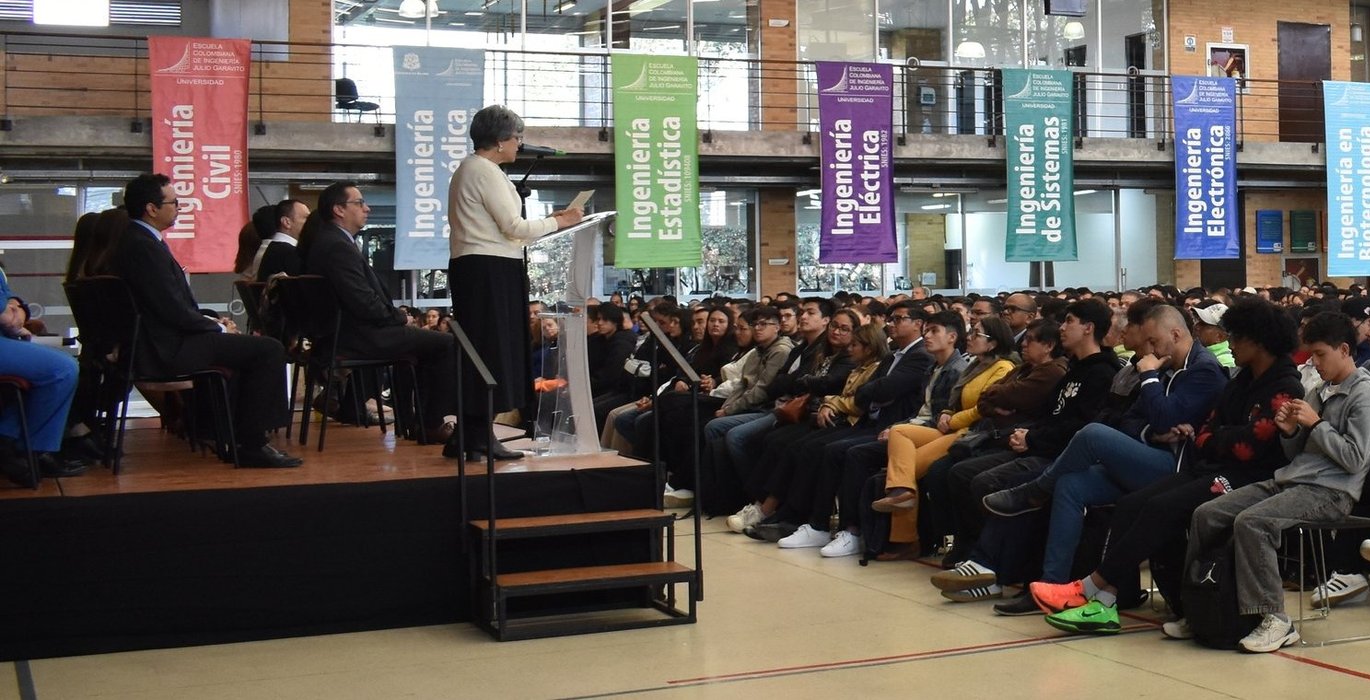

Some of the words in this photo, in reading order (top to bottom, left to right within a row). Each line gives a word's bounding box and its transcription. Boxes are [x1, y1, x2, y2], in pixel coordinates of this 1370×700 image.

[176, 78, 224, 86] UNIVERSIDAD
[164, 105, 203, 239] Ingeniería
[201, 145, 231, 199] Civil
[407, 110, 442, 238] Ingeniería
[625, 118, 658, 238] Ingeniería
[656, 116, 683, 240] Estadística
[829, 119, 859, 234] Ingeniería
[857, 130, 881, 224] Eléctrica
[1013, 124, 1041, 234] Ingeniería
[1040, 116, 1061, 211] Sistemas
[1182, 128, 1207, 233] Ingeniería
[1205, 125, 1225, 236] Electrónica
[1339, 128, 1353, 153] en
[1041, 216, 1062, 242] de
[1335, 157, 1358, 258] Ingeniería
